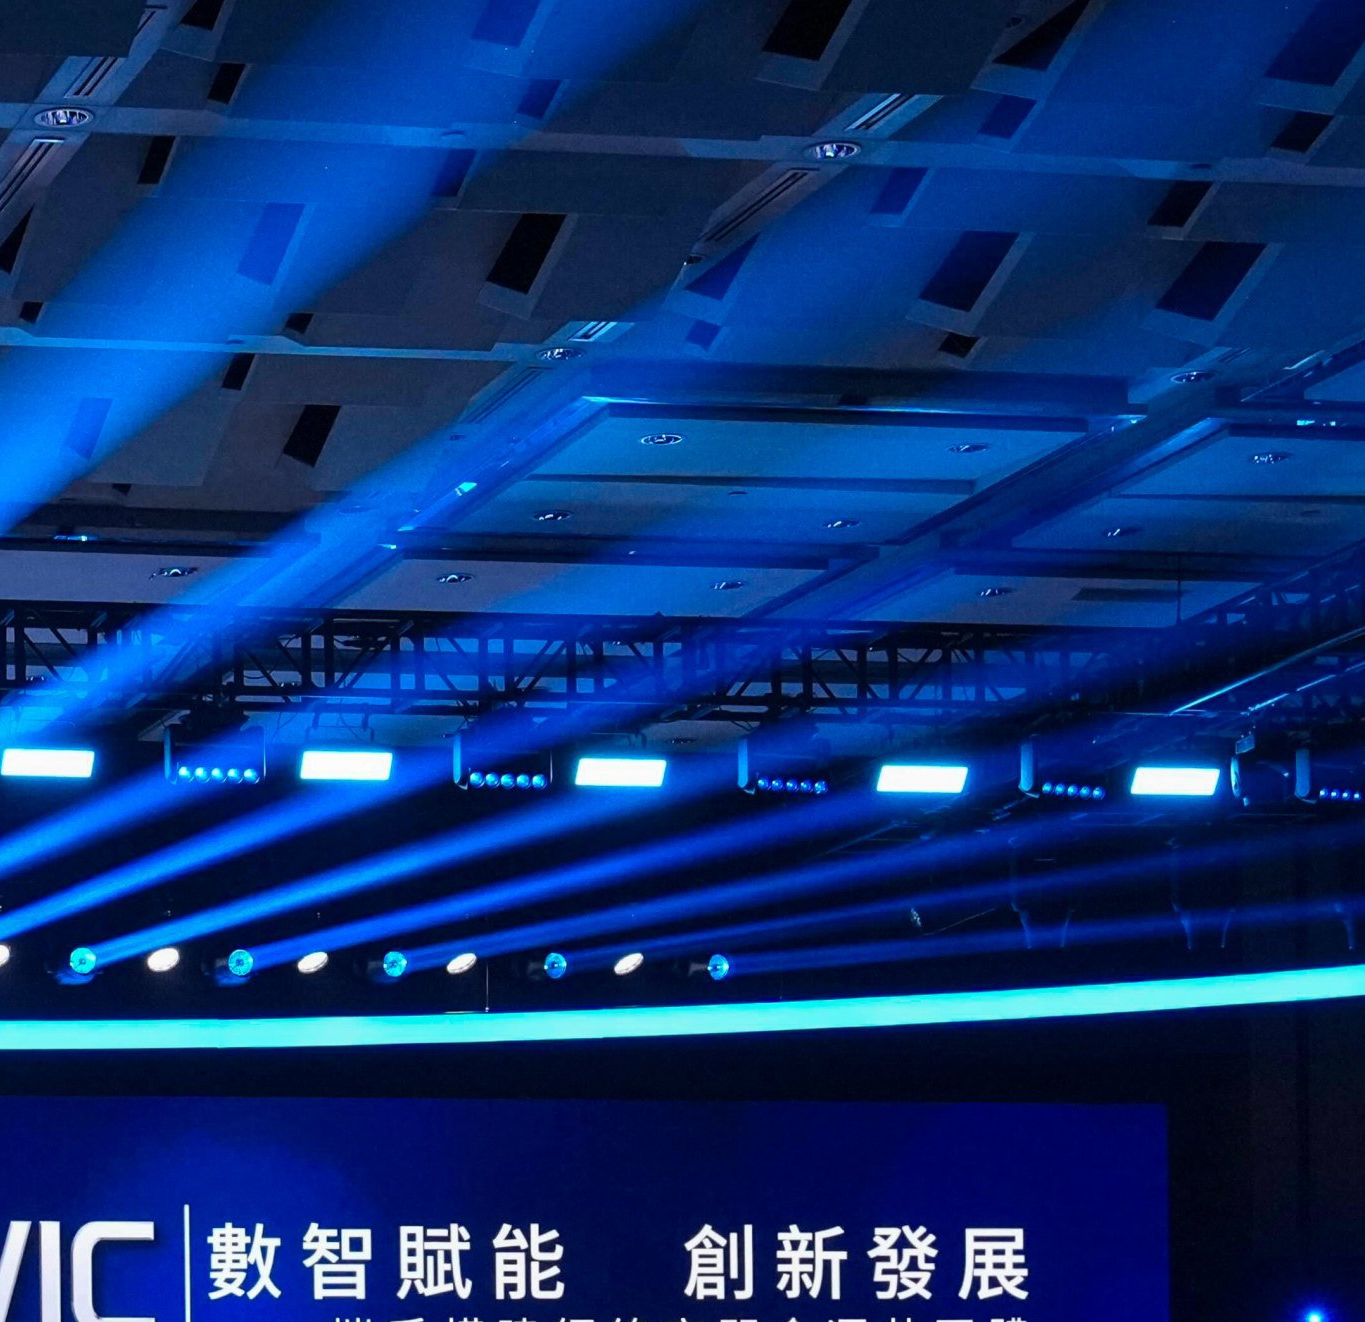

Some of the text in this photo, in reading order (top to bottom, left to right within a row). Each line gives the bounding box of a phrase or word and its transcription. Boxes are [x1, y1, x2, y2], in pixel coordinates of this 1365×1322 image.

[207, 1223, 1028, 1299] 數智賦能 創新發展
